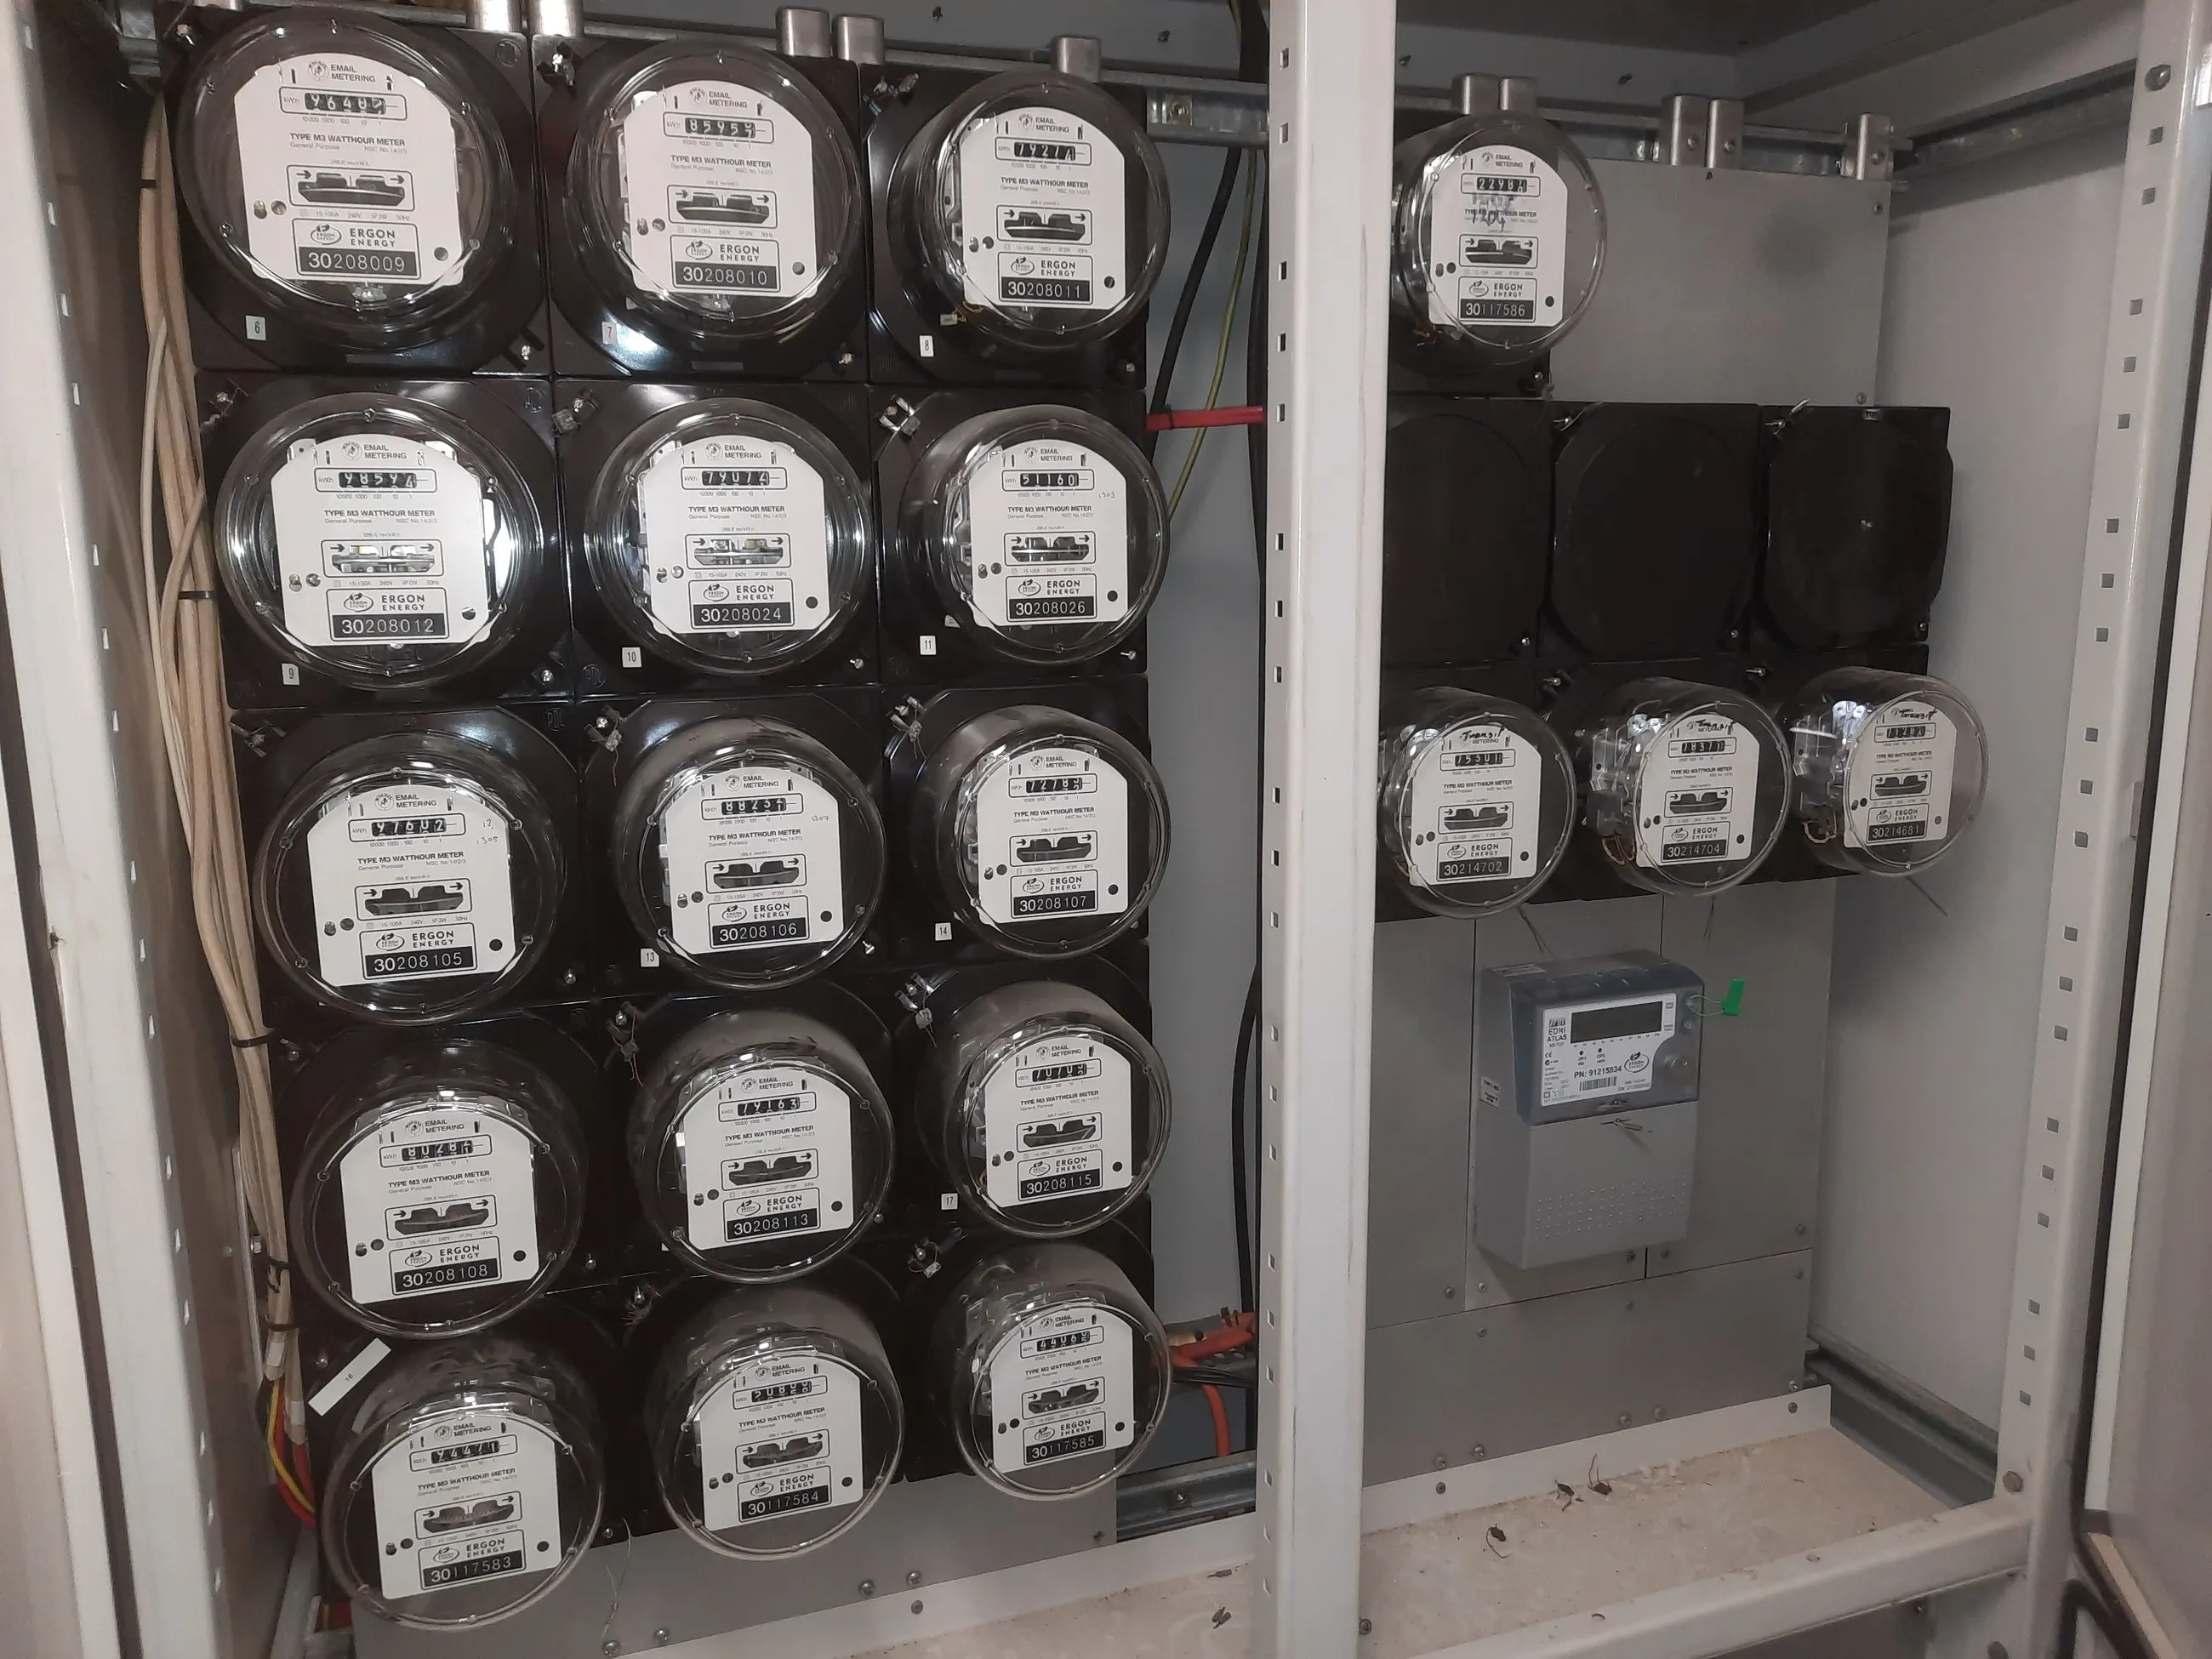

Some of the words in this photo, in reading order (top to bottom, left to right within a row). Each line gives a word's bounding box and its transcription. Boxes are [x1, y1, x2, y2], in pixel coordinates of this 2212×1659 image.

[330, 64, 356, 72] EMAIL
[331, 72, 375, 83] METERING
[709, 90, 731, 99] EMAIL
[709, 99, 747, 108] METERING
[328, 134, 374, 144] WATTHOUR
[349, 227, 395, 238] ERGON
[351, 238, 396, 247] ENERGY
[720, 243, 759, 254] ERGON
[308, 252, 405, 271] 30208009
[720, 254, 759, 262] ENERGY
[1040, 259, 1075, 269] ERGON
[682, 266, 767, 285] 30208010
[1007, 281, 1080, 298] 30208011
[1465, 302, 1526, 316] 30117586
[254, 321, 260, 334] 6
[607, 326, 613, 337] 7
[925, 339, 929, 351] 8
[1023, 473, 1078, 487] 51160
[736, 584, 773, 593] ERGON
[1046, 579, 1080, 588] ERGON
[380, 594, 425, 603] ERGON
[1015, 600, 1085, 615] 30208026
[700, 607, 781, 622] 30208024
[341, 618, 434, 634] 30208012
[925, 640, 932, 649] 11
[627, 652, 636, 662] 10
[288, 668, 294, 679] 9
[743, 780, 778, 789] METERING
[1872, 824, 1919, 838] 30214681
[1471, 842, 1498, 851] ERGON
[1667, 842, 1720, 857] 30214704
[392, 852, 436, 862] WATTHOUR
[1444, 860, 1502, 875] 30214702
[1050, 875, 1081, 885] ERGON
[753, 902, 790, 912] ERGON
[1019, 894, 1086, 912] 30208107
[754, 910, 790, 919] ENERGY
[412, 930, 453, 941] ERGON
[719, 921, 796, 942] 30208106
[939, 926, 947, 936] 14
[413, 938, 454, 948] ENERGY
[373, 951, 462, 972] 30208105
[646, 952, 655, 961] 13
[759, 1080, 793, 1090] METERING
[425, 1118, 448, 1126] EMAIL
[425, 1123, 464, 1133] METERING
[1056, 1155, 1086, 1166] ERGON
[1056, 1163, 1086, 1172] ENERGY
[421, 1173, 463, 1183] WATTHOUR
[464, 1170, 490, 1178] METER
[1026, 1173, 1092, 1194] 30208115
[767, 1194, 801, 1206] ERGON
[946, 1196, 954, 1205] 17
[767, 1202, 801, 1212] ENERGY
[733, 1212, 808, 1235] 30208113
[439, 1244, 479, 1257] ERGON
[440, 1251, 480, 1263] ENERGY
[402, 1263, 487, 1287] 30208108
[453, 1422, 476, 1430] EMAIL
[1060, 1418, 1090, 1430] ERGON
[453, 1425, 491, 1437] METERING
[1060, 1425, 1090, 1436] ENERGY
[1031, 1434, 1095, 1459] 30117585
[779, 1473, 813, 1485] ERGON
[780, 1480, 813, 1491] ENERGY
[748, 1490, 819, 1515] 30117584
[465, 1537, 505, 1551] ERGON
[466, 1545, 505, 1558] ENERGY
[430, 1555, 512, 1582] 30117583
